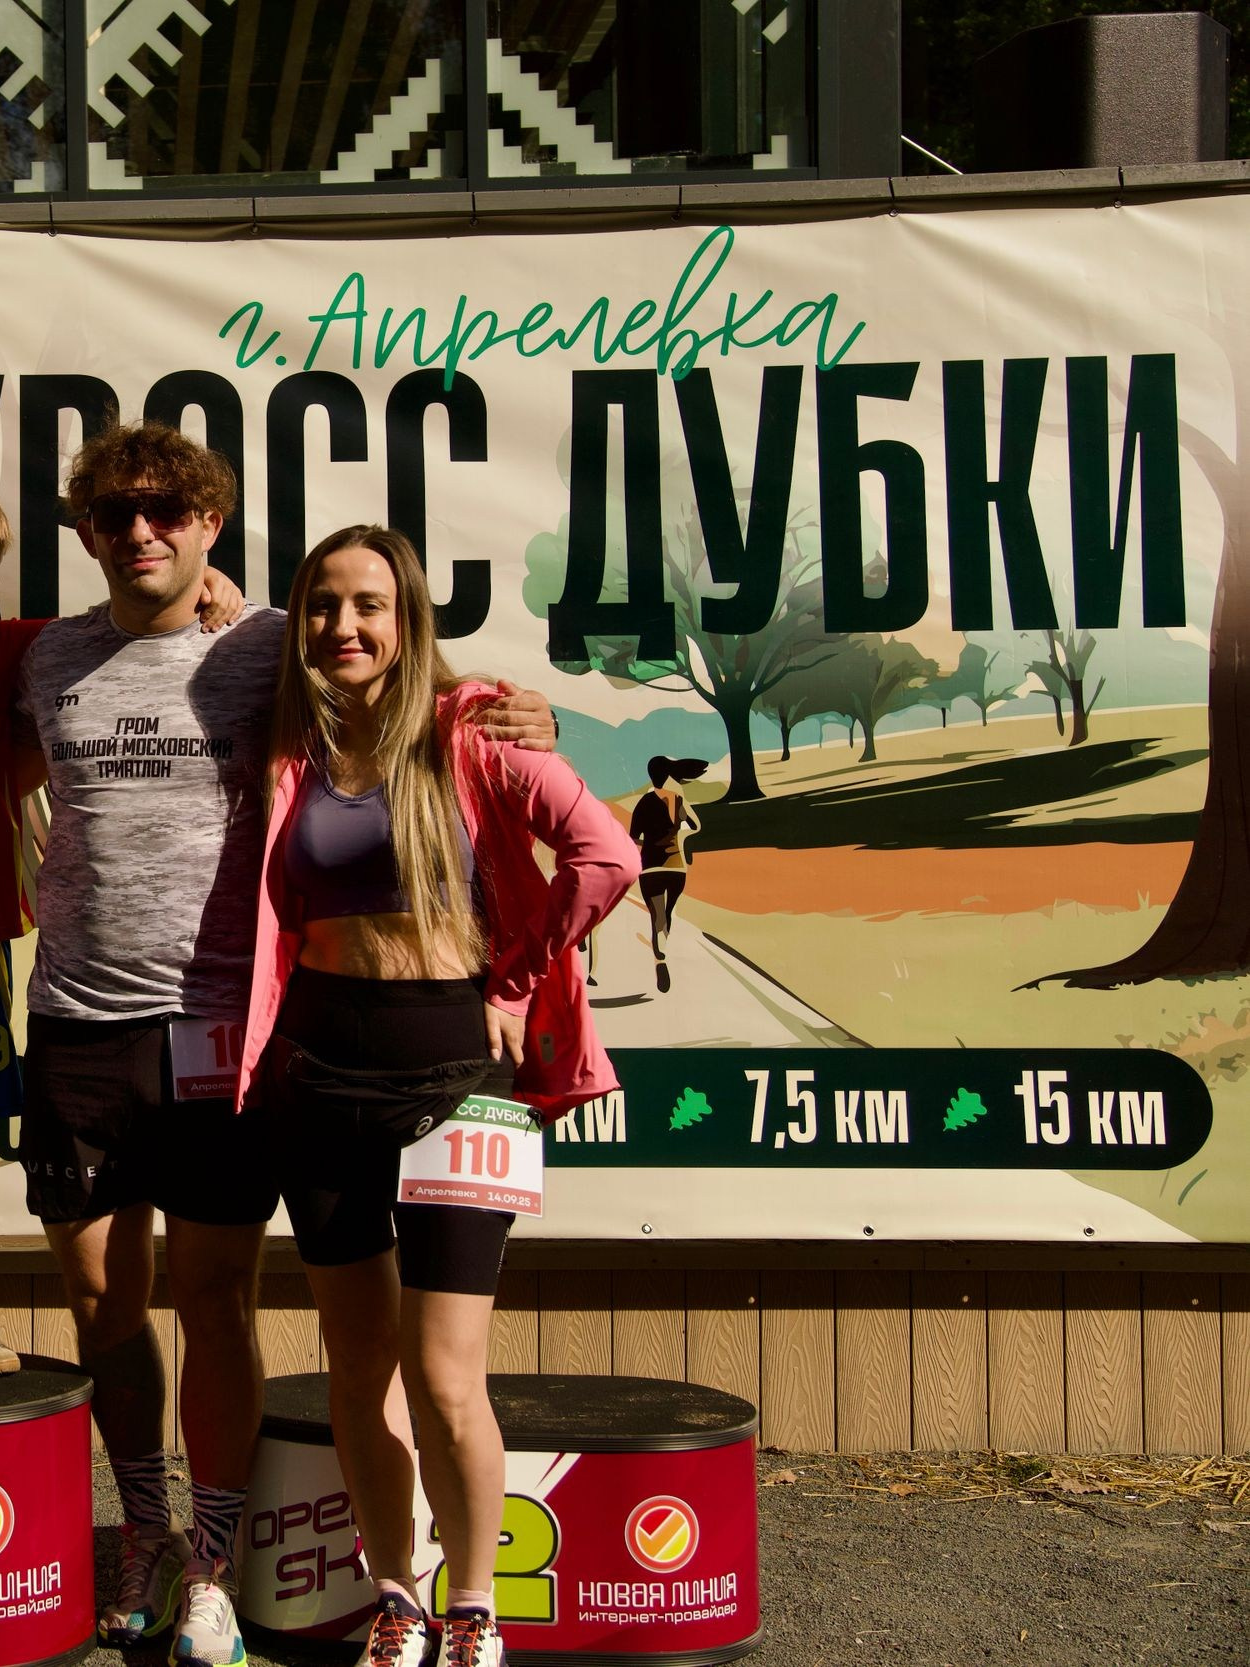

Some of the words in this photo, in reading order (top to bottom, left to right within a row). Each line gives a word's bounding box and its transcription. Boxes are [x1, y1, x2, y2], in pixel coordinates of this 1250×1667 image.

[548, 353, 1186, 662] ДУБКИ
[115, 717, 160, 736] ГРОМ
[52, 736, 117, 762] БОЛЬШОЙ
[122, 737, 233, 759] МОСКОВСКИЙ
[97, 760, 171, 778] ТРИАТЛОН
[191, 1081, 236, 1094] Апреле
[484, 1106, 531, 1125] ДУБКИ
[744, 1070, 817, 1149] 7,5
[1014, 1070, 1070, 1144] 15
[443, 1129, 510, 1179] 110
[415, 1186, 477, 1198] Апрелевка
[487, 1191, 531, 1207] 14.09.25
[250, 1491, 356, 1551] OPE
[275, 1535, 368, 1601] SK
[578, 1581, 665, 1608] НОВАЯ
[671, 1572, 737, 1607] ЛИНИЯ
[578, 1602, 737, 1625] интернет-провайдер
